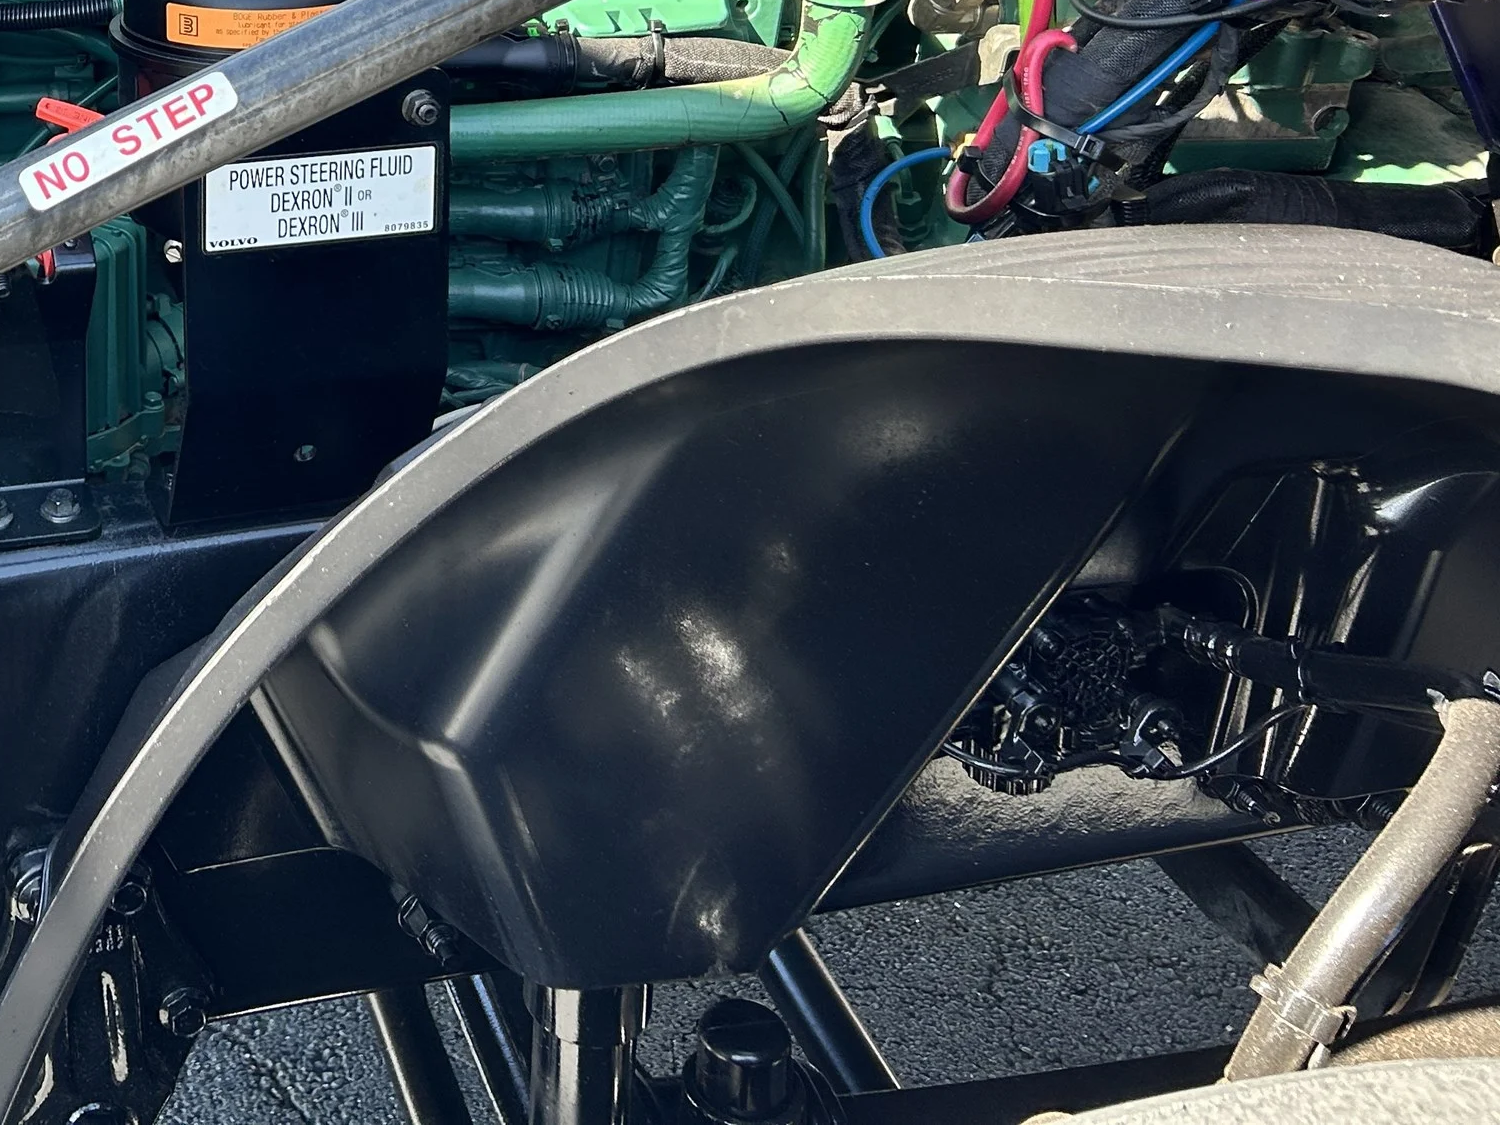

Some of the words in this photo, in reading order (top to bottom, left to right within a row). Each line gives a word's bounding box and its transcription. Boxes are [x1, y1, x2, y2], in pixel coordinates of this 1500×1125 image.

[257, 12, 288, 21] Rubber
[261, 28, 270, 36] by
[32, 151, 91, 200] NO
[111, 83, 214, 156] STEP
[229, 166, 285, 191] POWER
[289, 159, 365, 186] STEERING
[370, 154, 413, 179] FLUID
[344, 186, 353, 206] II
[357, 189, 372, 201] OR
[351, 211, 364, 231] III
[209, 236, 258, 249] VOLVO
[384, 221, 429, 232] 8079835
